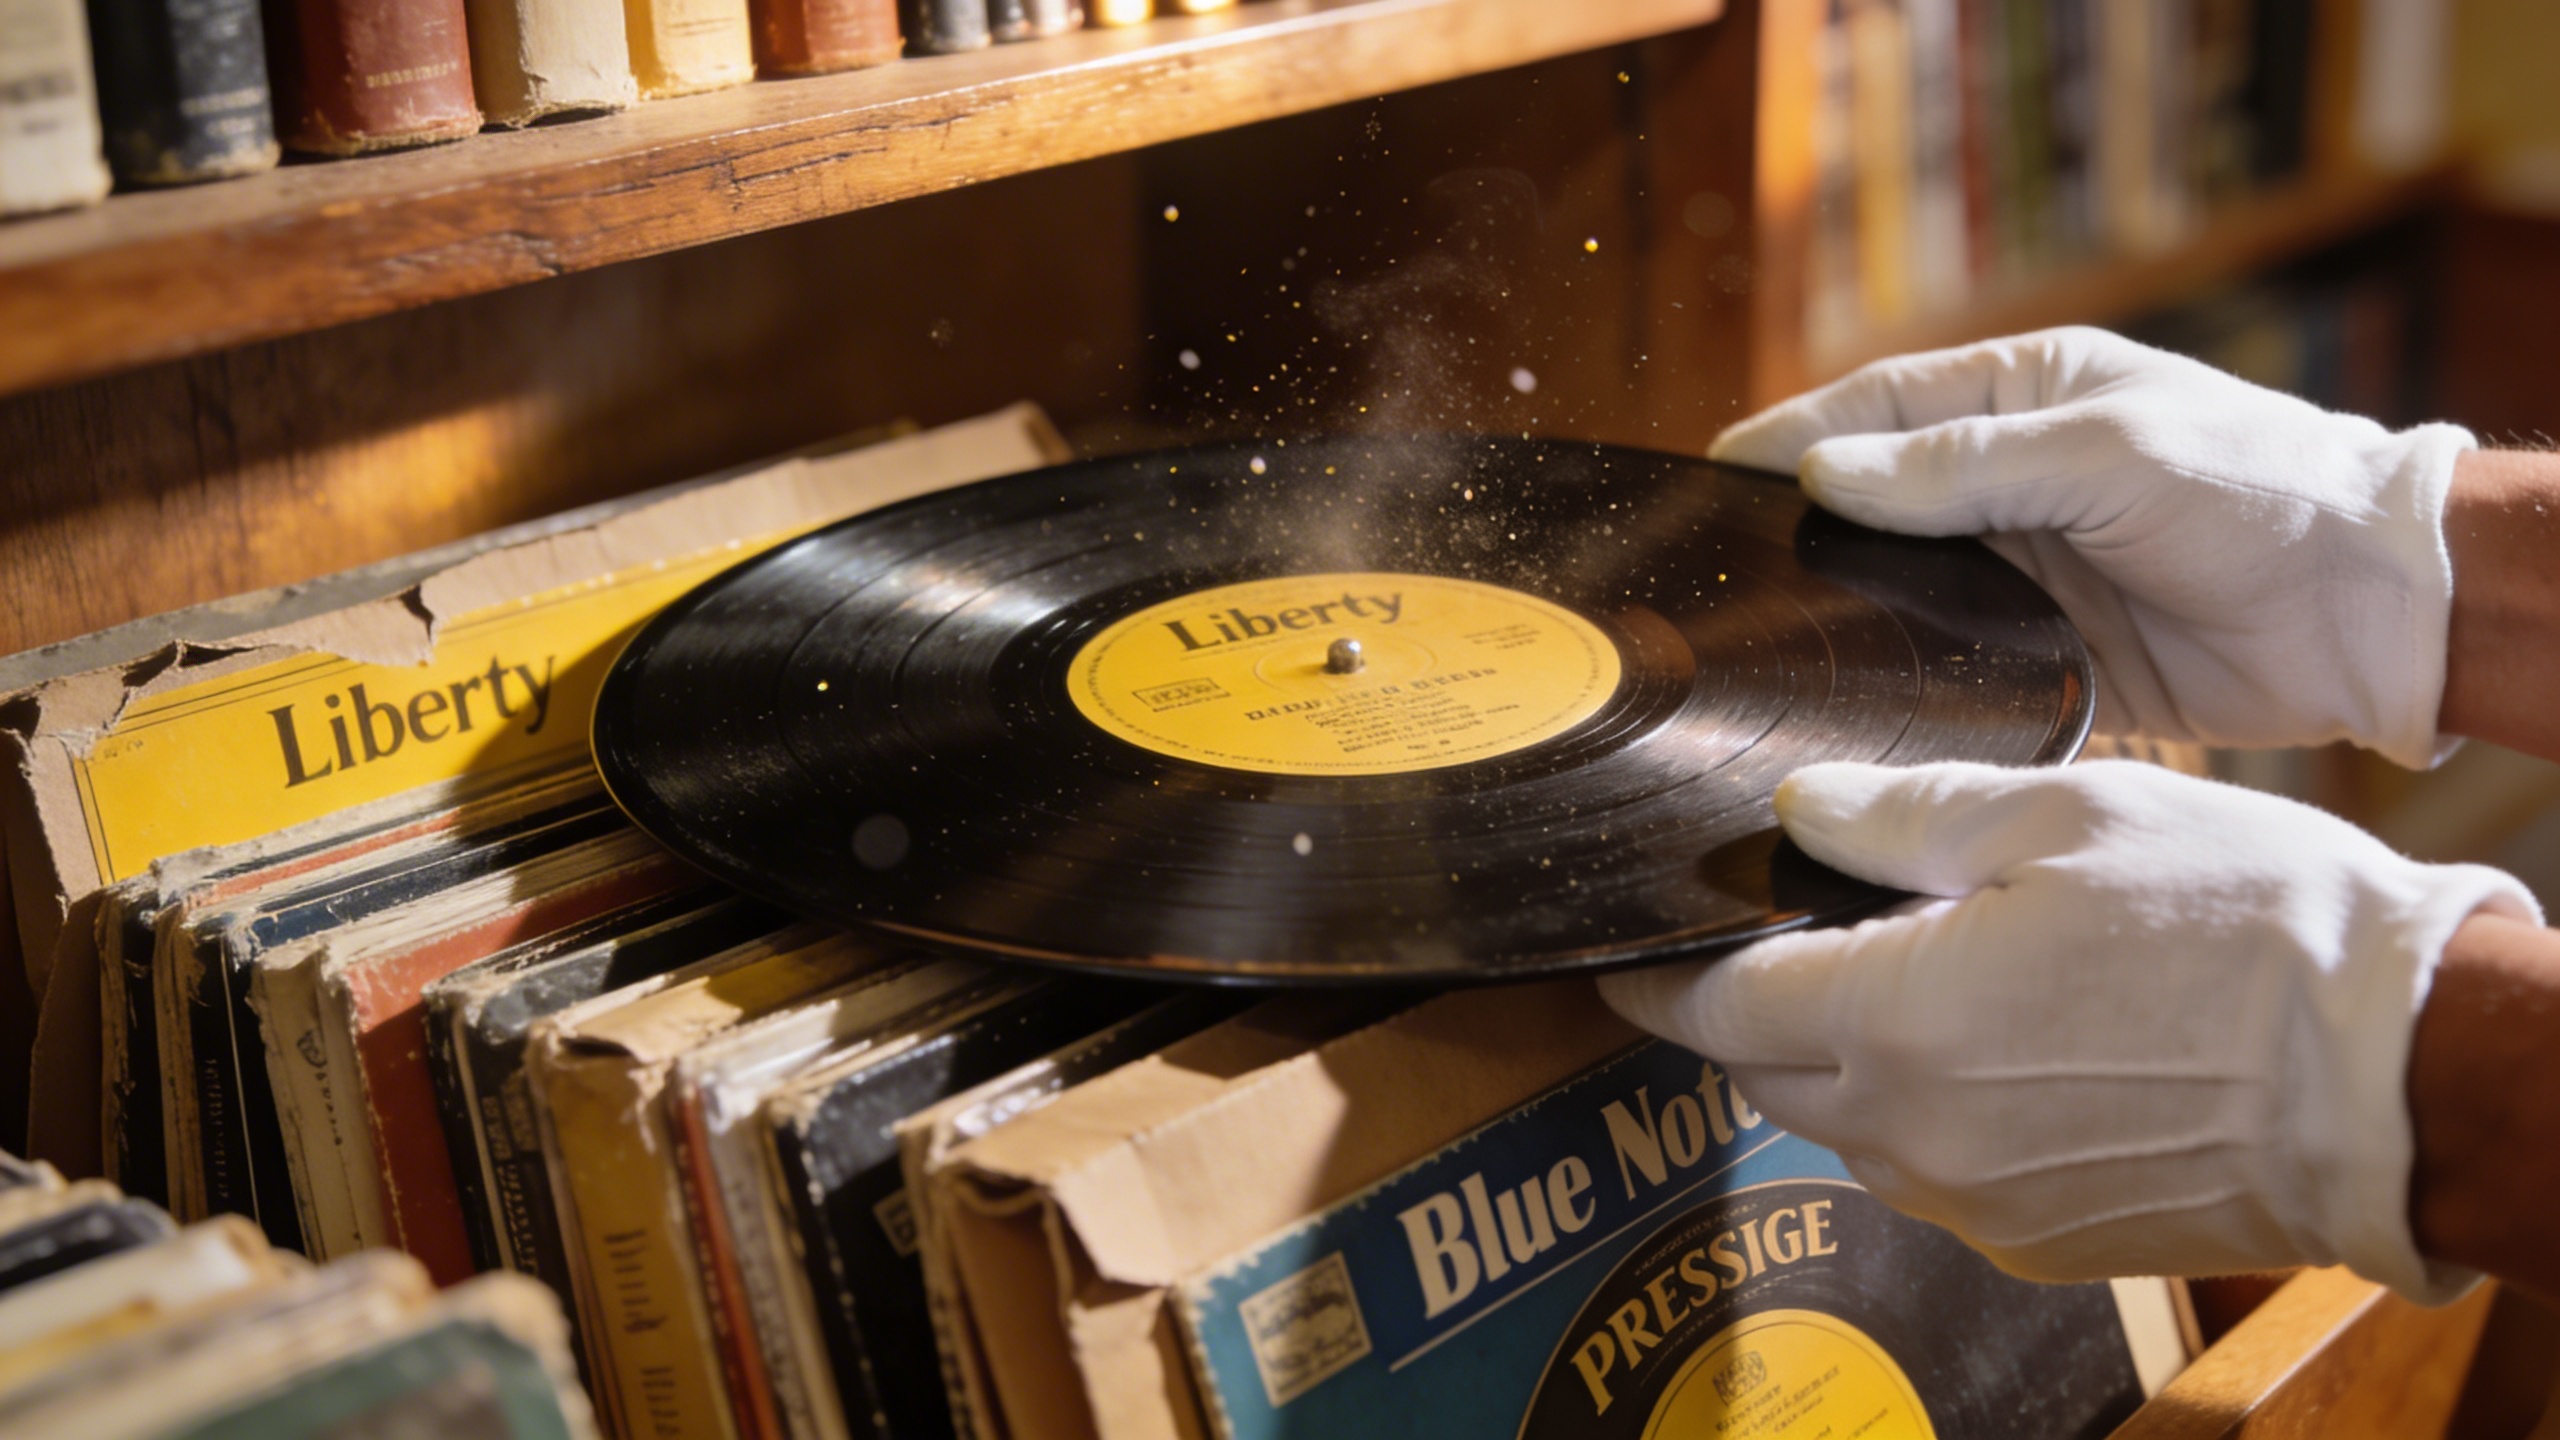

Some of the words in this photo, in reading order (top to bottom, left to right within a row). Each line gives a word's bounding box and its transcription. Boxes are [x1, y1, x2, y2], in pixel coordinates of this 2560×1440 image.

[1163, 589, 1404, 653] Liberty
[266, 654, 559, 788] Liberty
[1396, 1155, 1598, 1321] Blue
[1568, 1199, 1839, 1417] PRESSIGE
